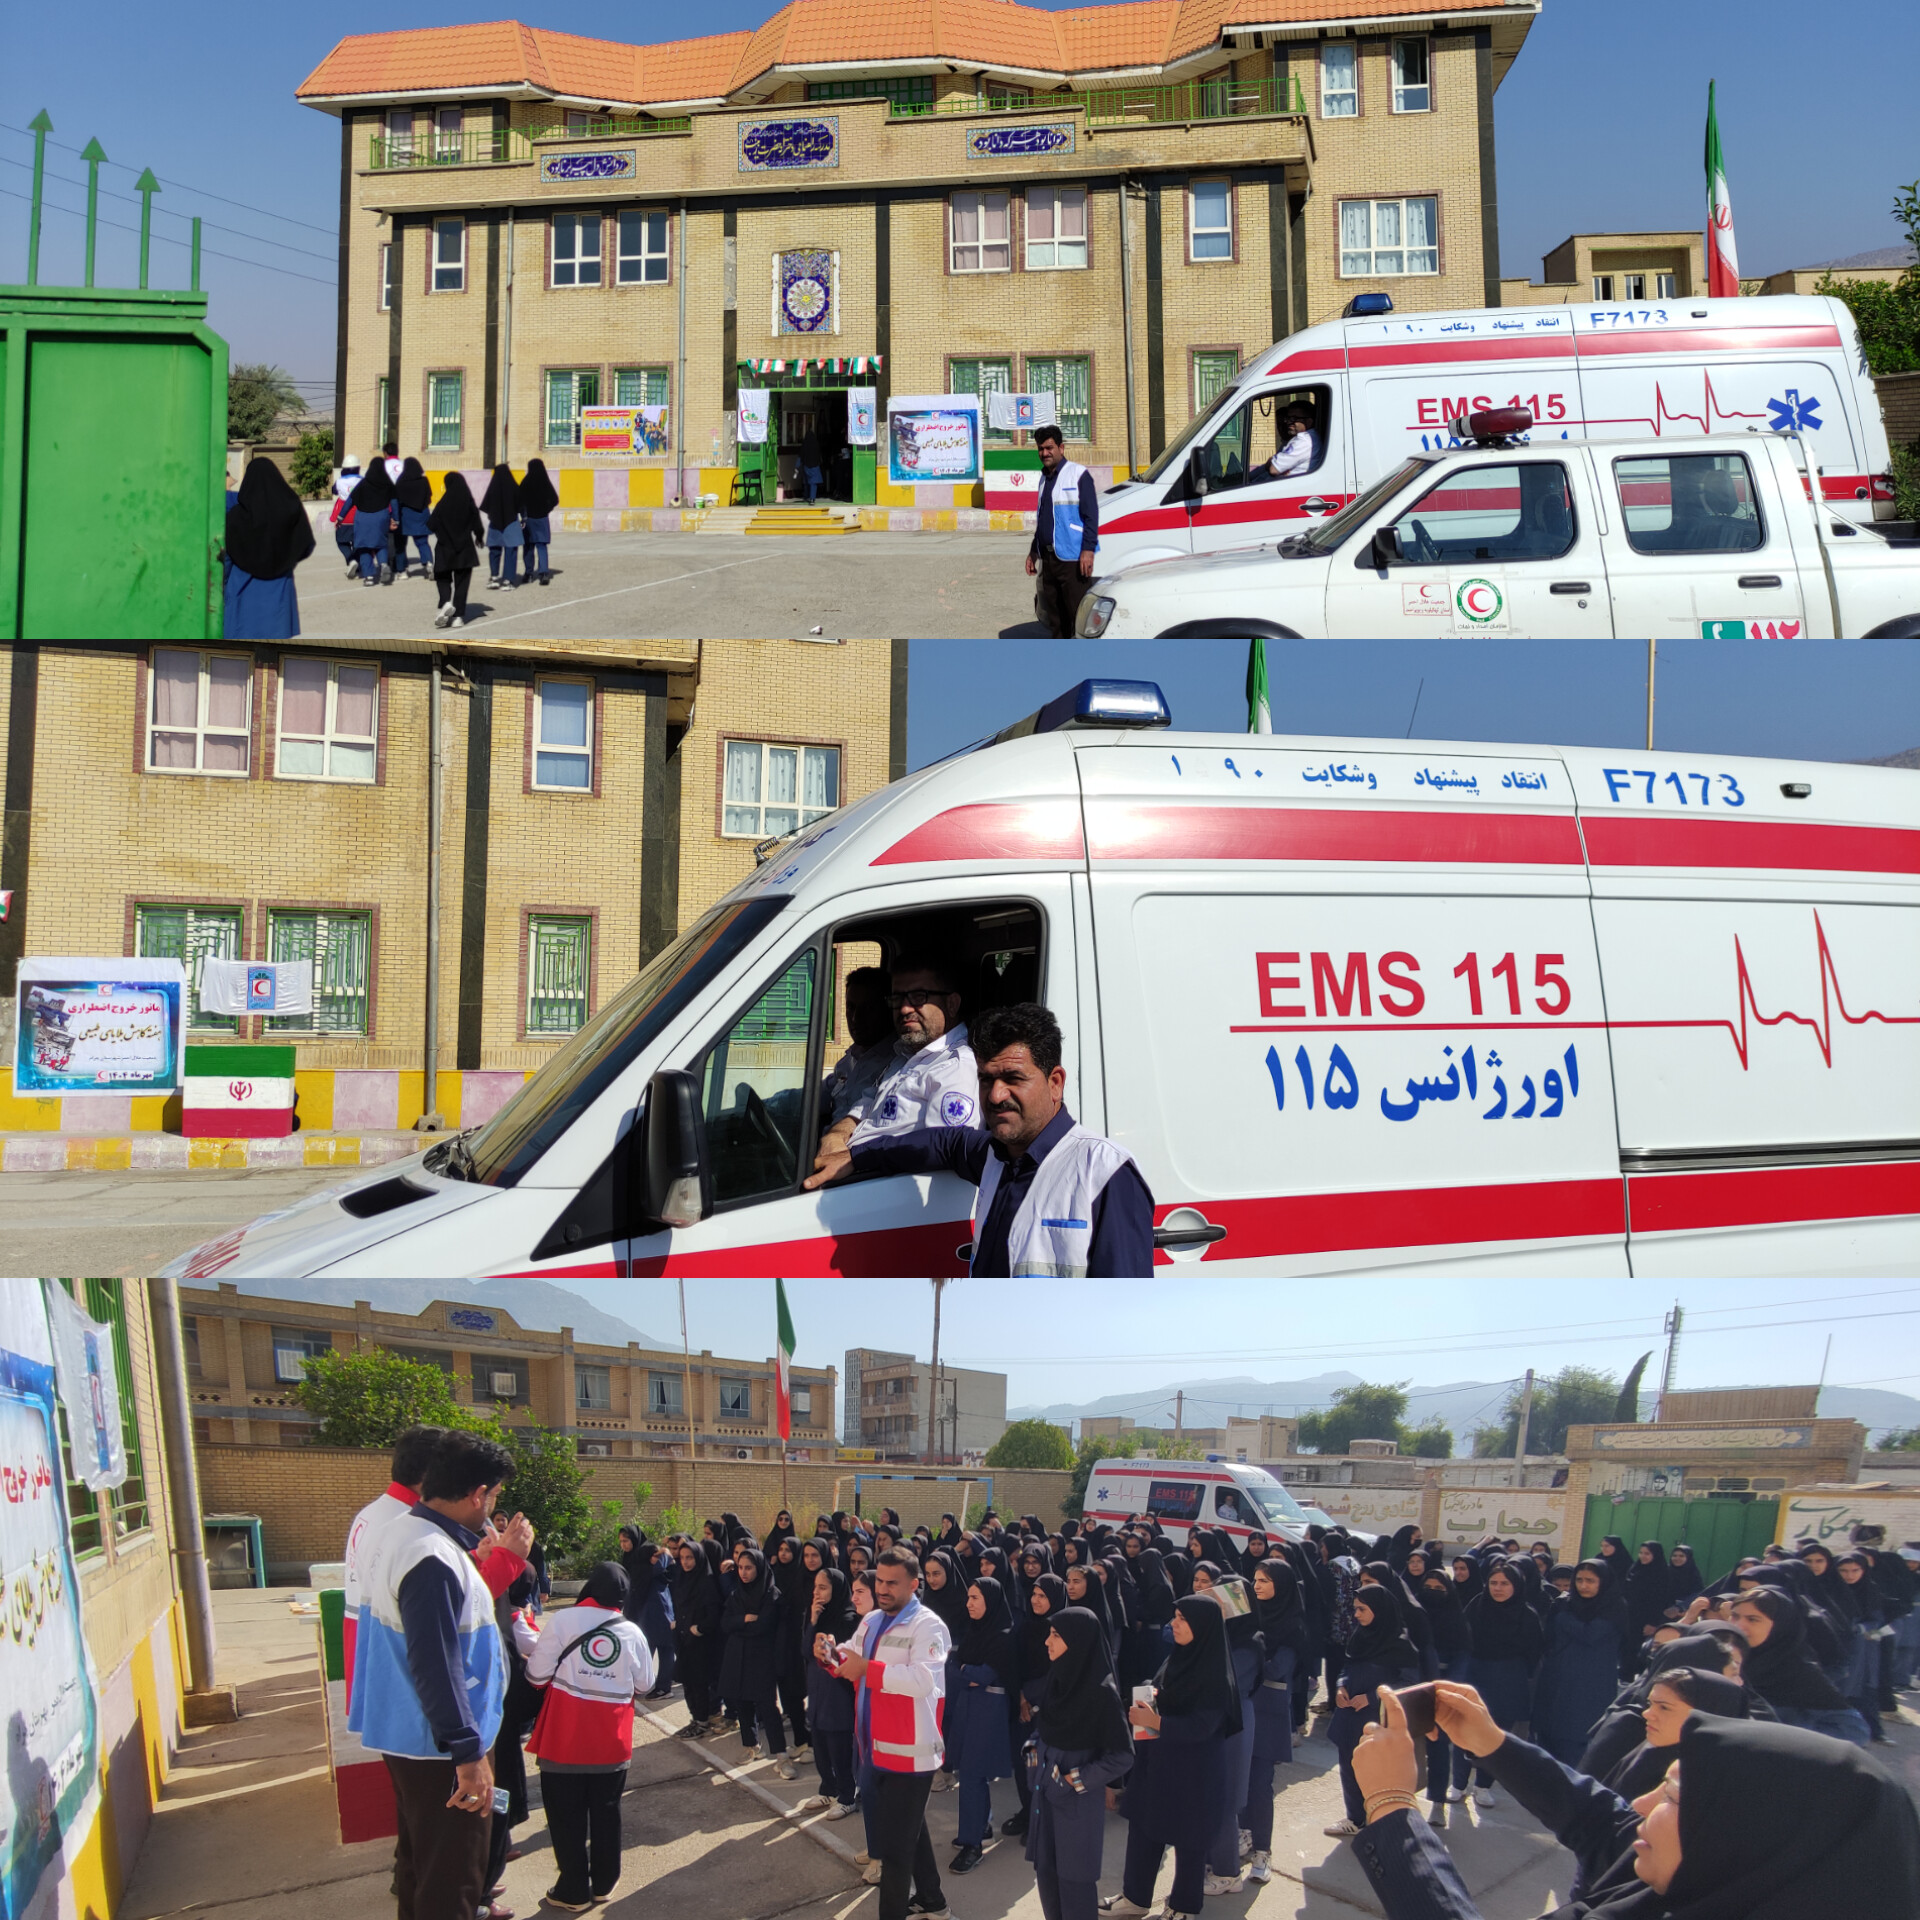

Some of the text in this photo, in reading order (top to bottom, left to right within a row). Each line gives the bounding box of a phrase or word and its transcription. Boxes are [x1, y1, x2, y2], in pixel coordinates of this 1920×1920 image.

[1492, 320, 1524, 331] پیشنهاد
[1535, 318, 1560, 328] انتقاد
[1590, 309, 1669, 329] F7173
[1413, 767, 1480, 796] پیشنهاد
[1500, 769, 1549, 791] انتقاد
[1601, 767, 1746, 808] F7173
[1255, 951, 1572, 1018] EMS 115
[67, 1002, 161, 1015] مانور خروج اضطراری
[1265, 1043, 1580, 1122] اورژانس ۱۱۵
[1155, 1488, 1177, 1498] EMS
